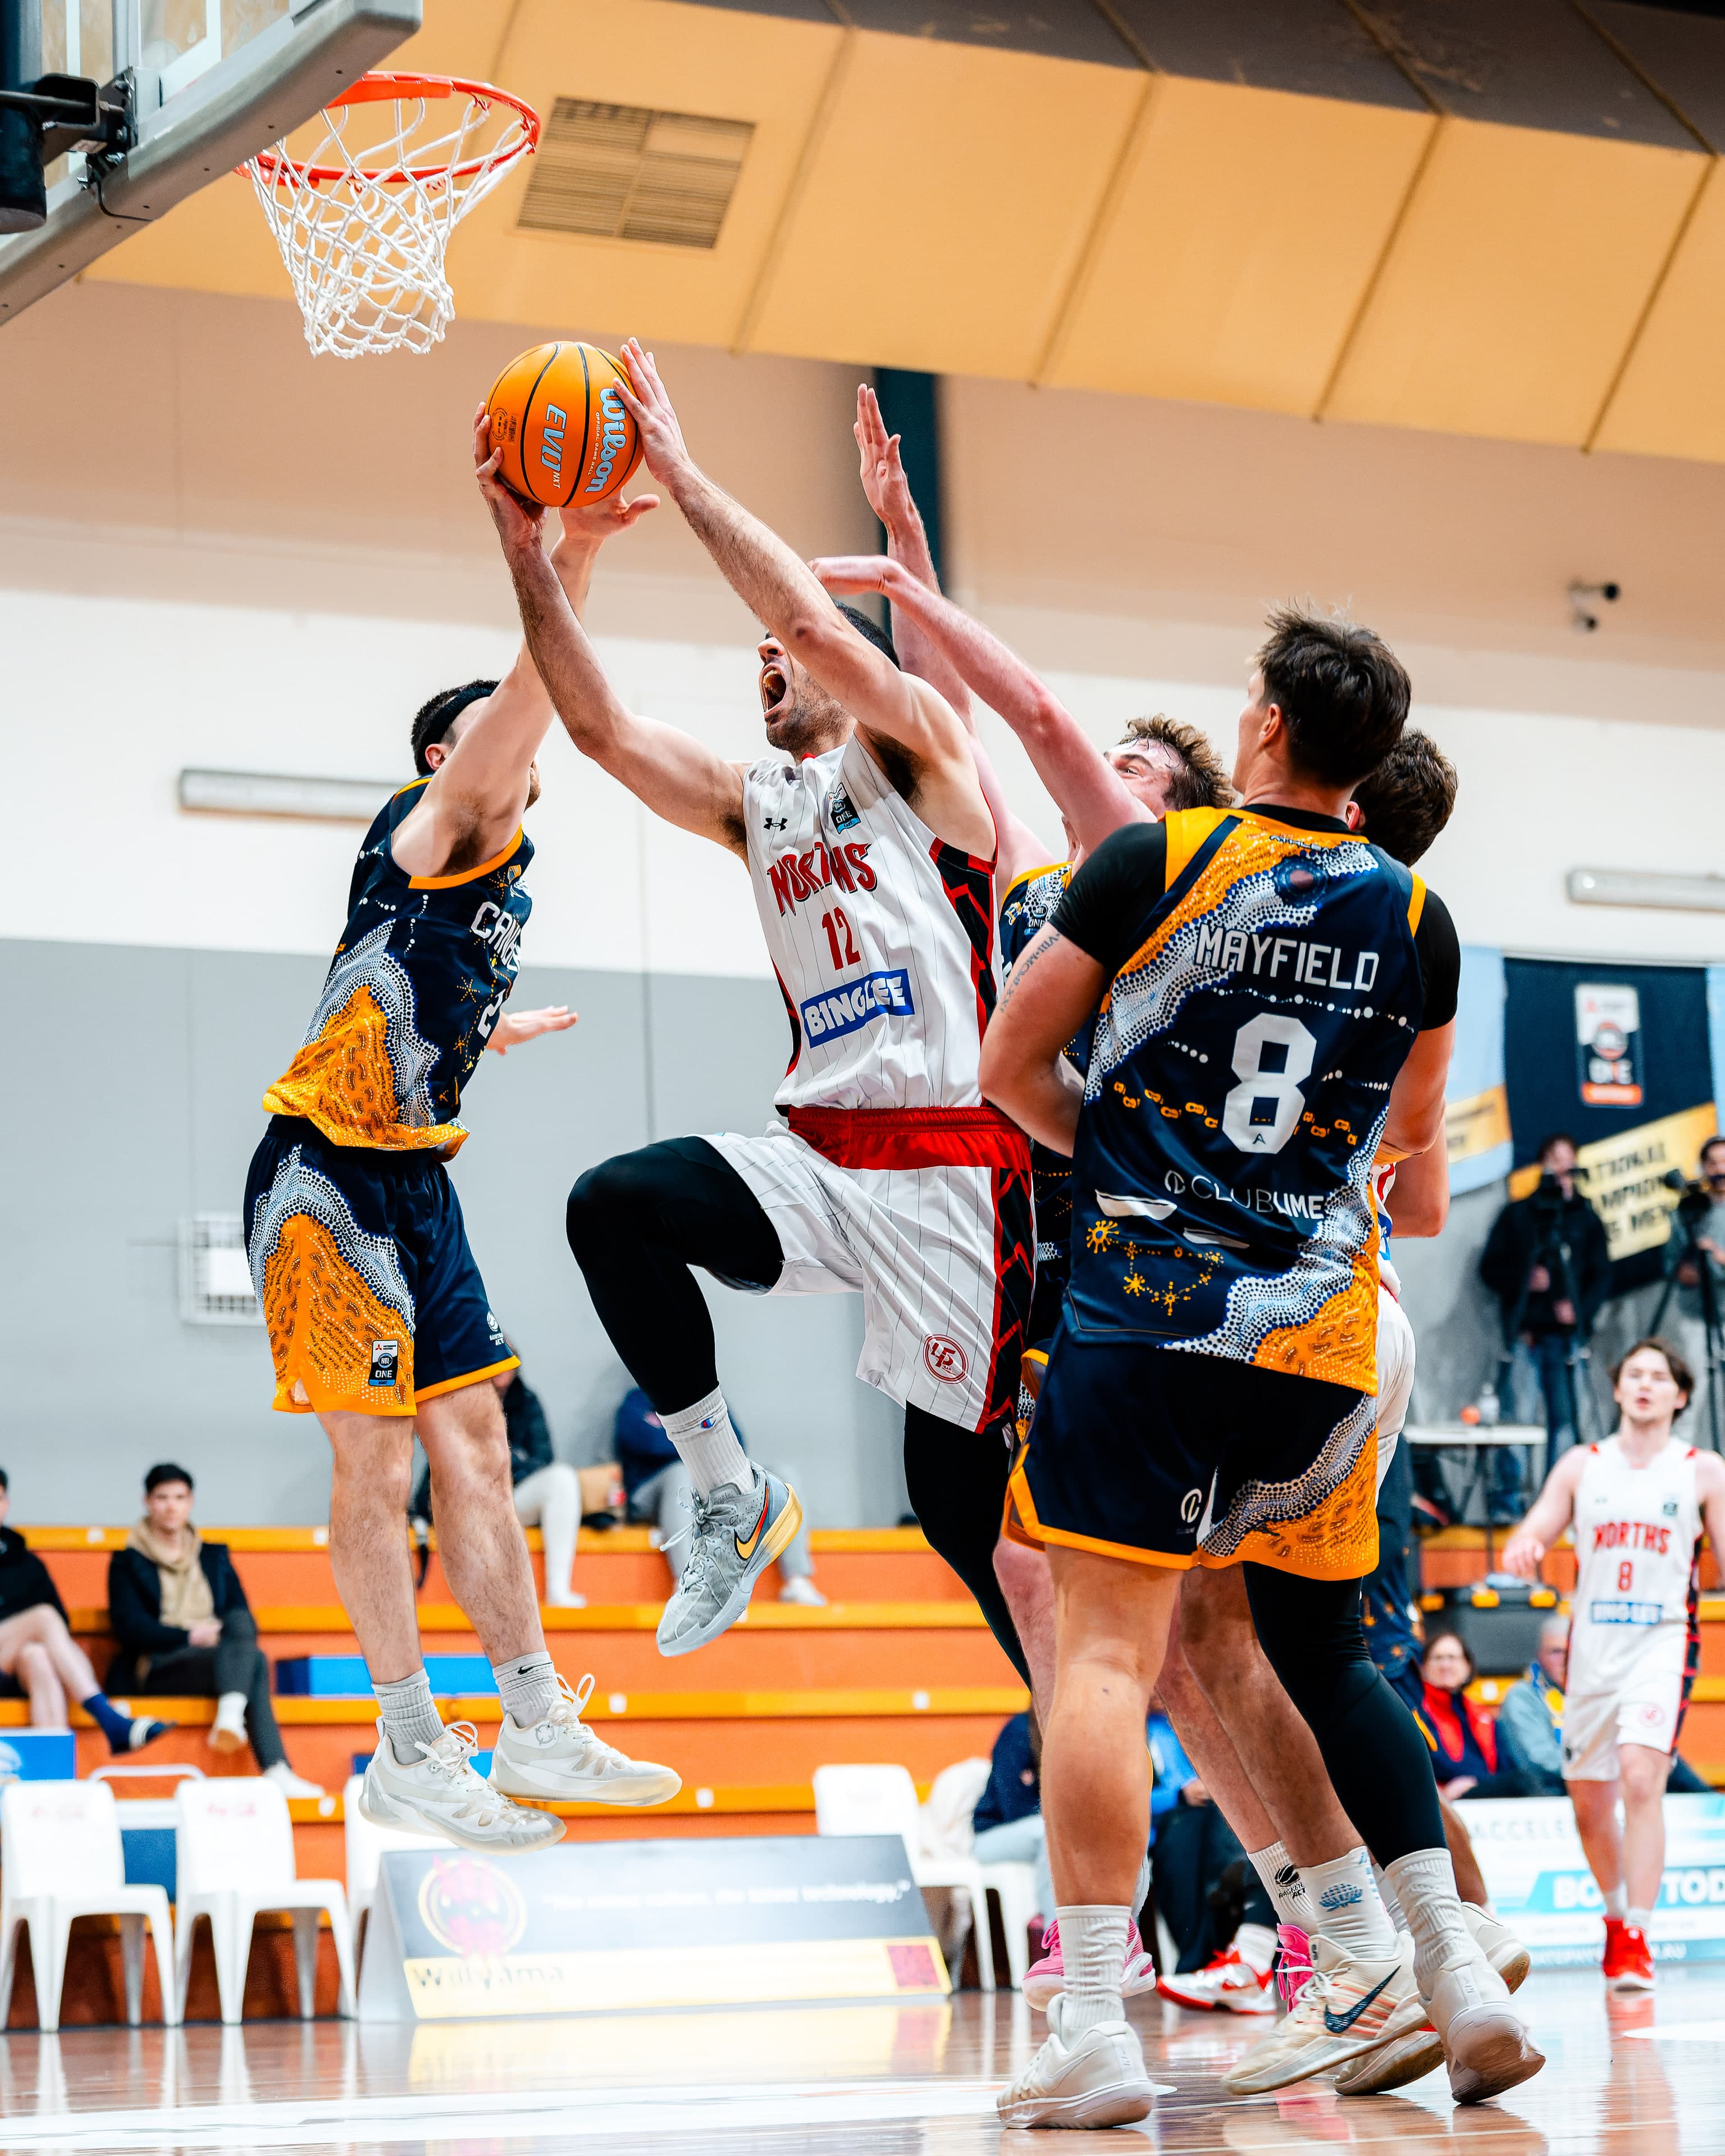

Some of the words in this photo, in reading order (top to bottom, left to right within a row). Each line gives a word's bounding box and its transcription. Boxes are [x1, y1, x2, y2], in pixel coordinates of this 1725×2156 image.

[541, 403, 567, 472] EVO
[585, 387, 627, 492] Wilson
[766, 842, 877, 917] NORTHS
[822, 906, 861, 971] 12
[1194, 924, 1380, 993] MAYFIELD
[1222, 1012, 1317, 1154] 8
[1593, 1522, 1671, 1555] NORTHS
[1618, 1561, 1632, 1591] 8
